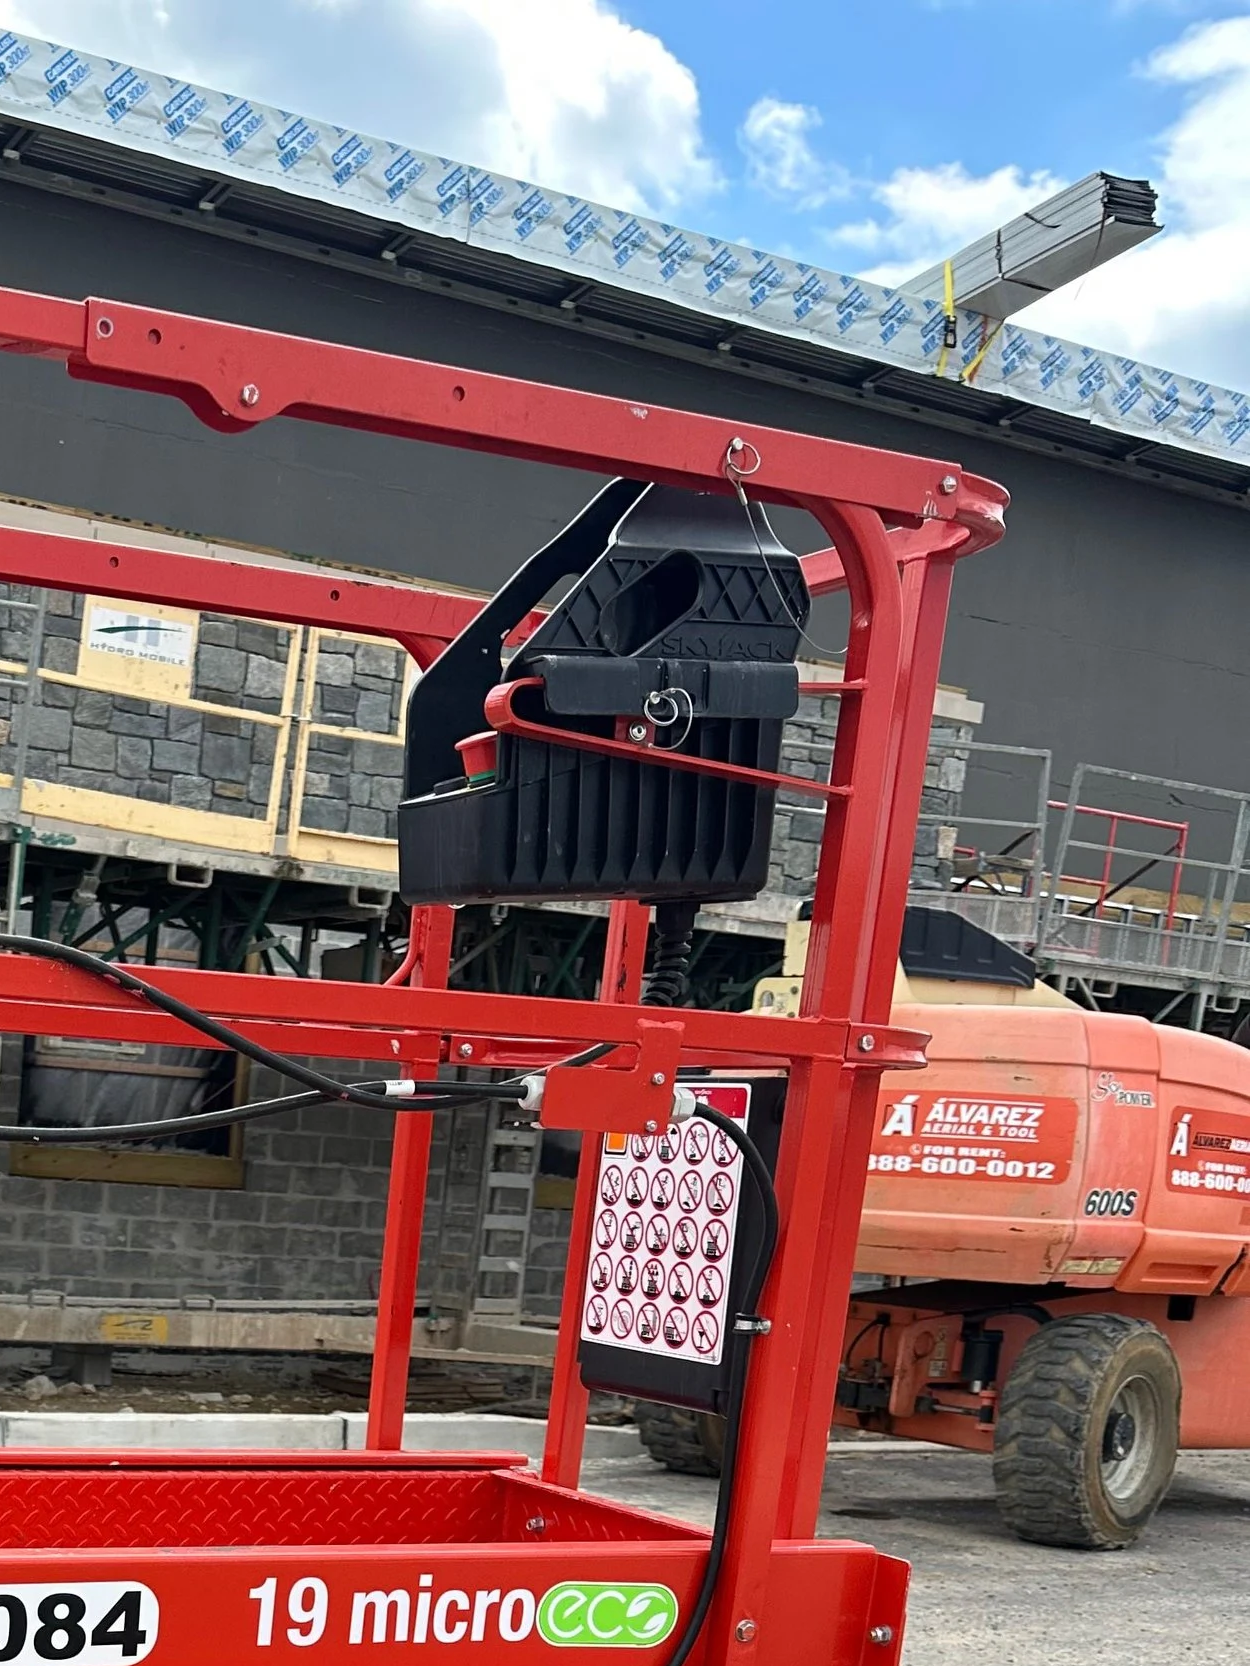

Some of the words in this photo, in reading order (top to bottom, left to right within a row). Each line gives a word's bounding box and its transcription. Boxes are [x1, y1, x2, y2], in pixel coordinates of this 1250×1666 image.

[46, 79, 68, 102] WIP
[106, 98, 128, 120] WIP
[164, 114, 184, 136] WIP
[222, 130, 242, 152] WIP
[278, 148, 299, 169] WIP
[90, 642, 135, 657] HYDRO
[138, 651, 186, 666] MOBILE
[660, 633, 792, 660] SKYJACK
[881, 1095, 920, 1137] Á
[925, 1097, 1044, 1127] ÁLVAREZ
[921, 1122, 977, 1136] AERIAL
[981, 1125, 994, 1136] &
[999, 1126, 1038, 1139] TOOL
[923, 1144, 955, 1156] FOR
[958, 1146, 1007, 1159] RENT:
[1084, 1189, 1138, 1217] 600S
[249, 1577, 330, 1647] 19
